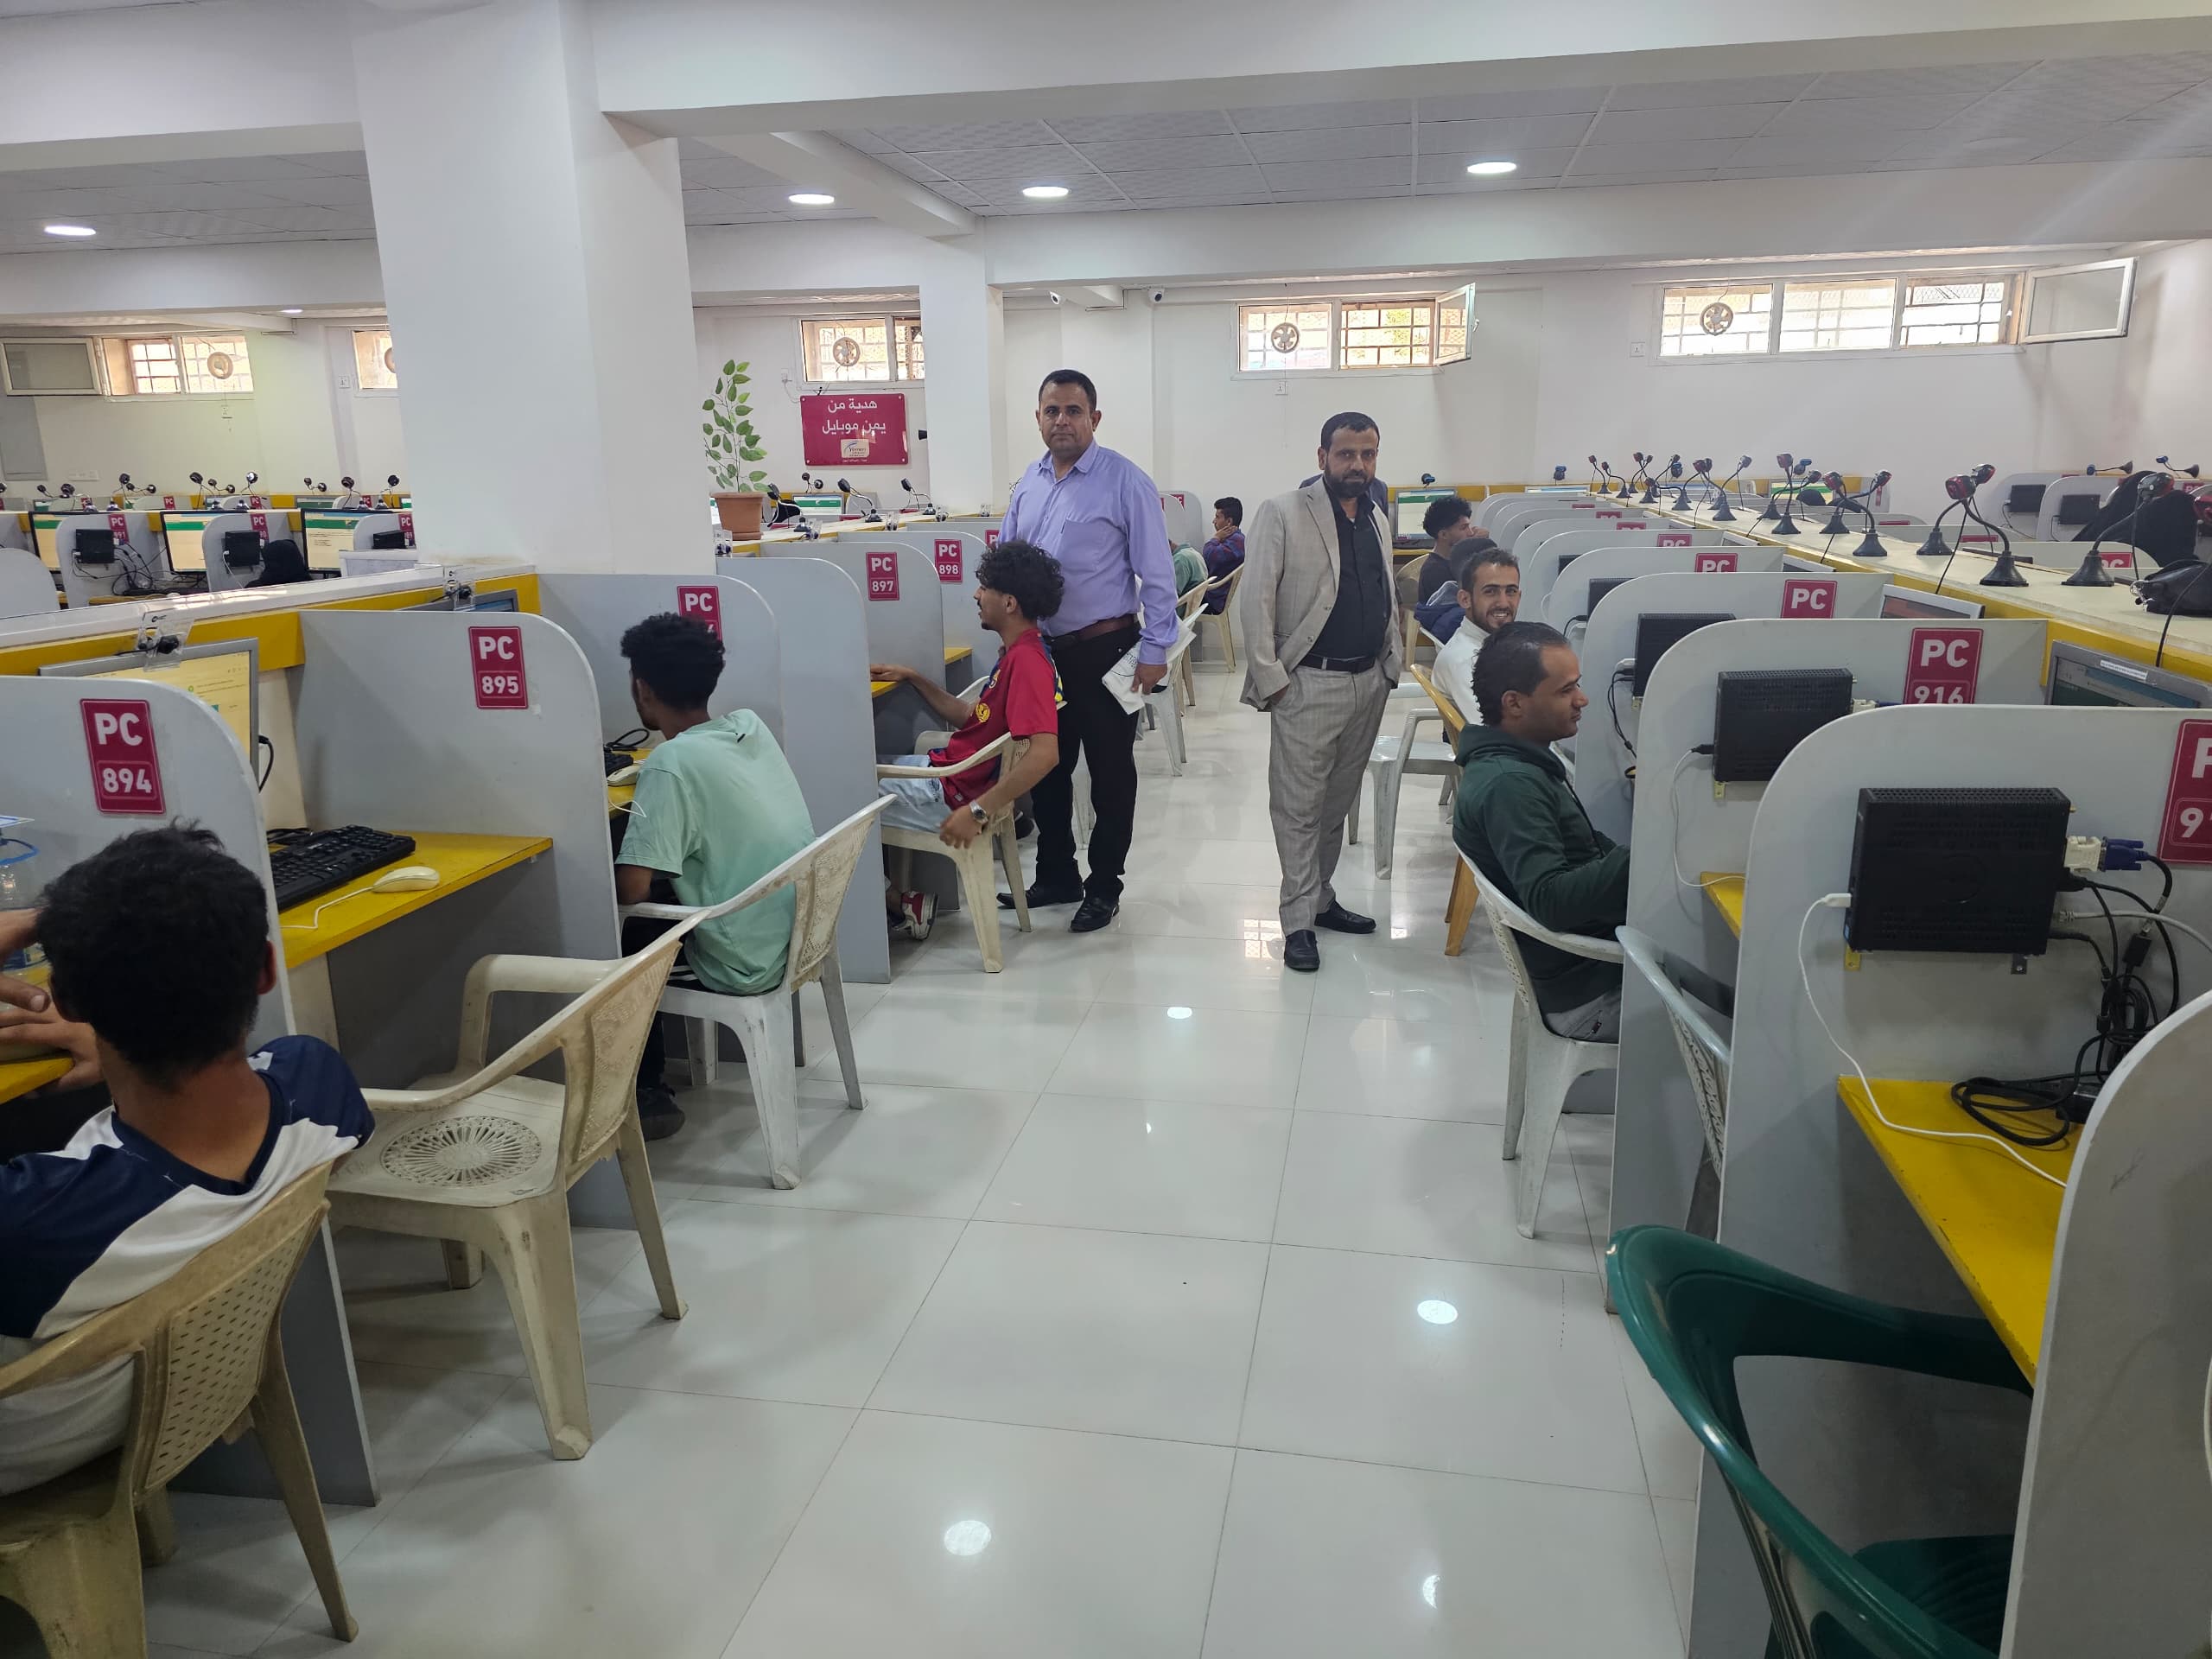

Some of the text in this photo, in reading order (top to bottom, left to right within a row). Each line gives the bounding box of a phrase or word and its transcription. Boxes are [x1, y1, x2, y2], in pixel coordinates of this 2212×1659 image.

[828, 397, 878, 414] هدية من
[822, 419, 887, 435] يمن موبايل
[111, 517, 124, 526] PC
[253, 516, 264, 526] PC
[401, 517, 411, 526] PC
[938, 543, 958, 557] PC
[871, 557, 893, 572] PC
[938, 564, 959, 575] 898
[1703, 560, 1731, 572] PC
[872, 581, 894, 593] 897
[684, 593, 713, 612] PC
[1790, 588, 1828, 610] PC
[478, 635, 515, 660] PC
[1920, 639, 1970, 668] PC
[481, 676, 519, 695] 895
[1914, 685, 1964, 704] 916
[94, 712, 143, 746] PC
[102, 767, 152, 793] 894
